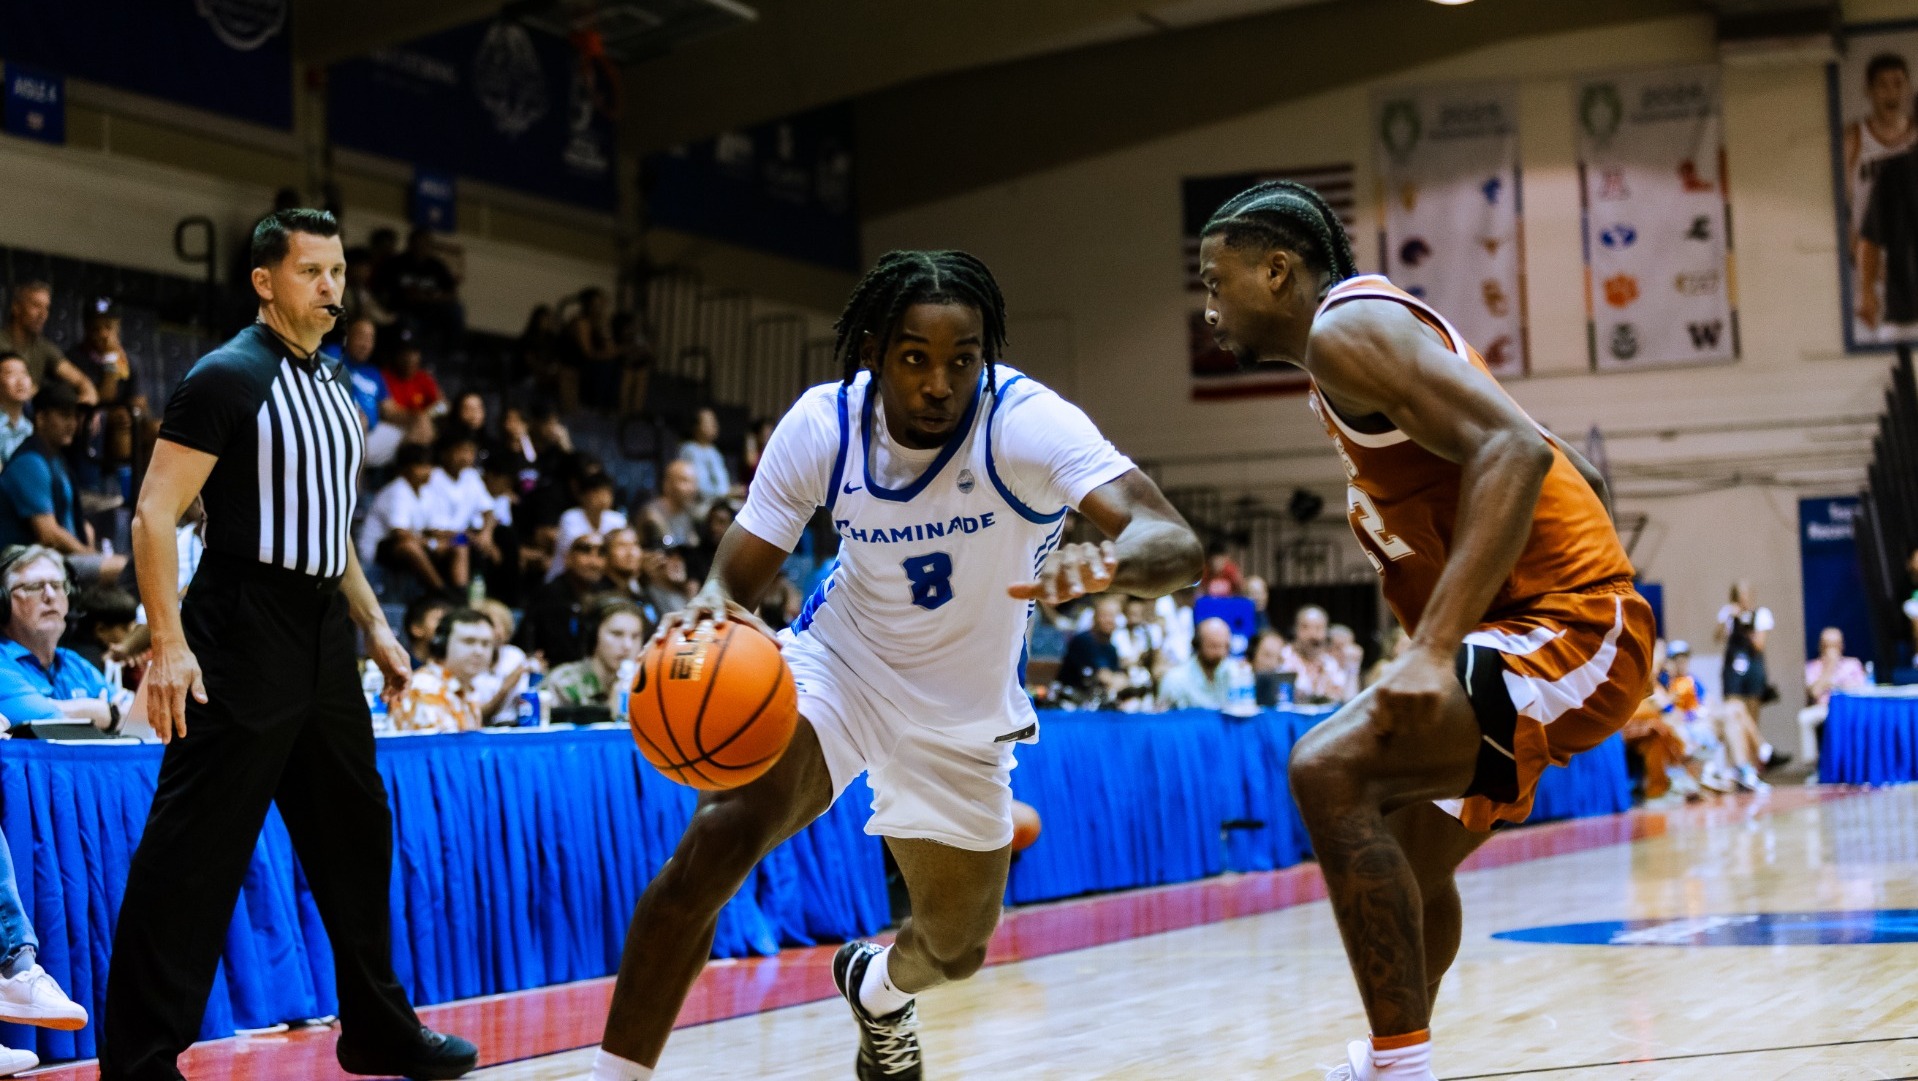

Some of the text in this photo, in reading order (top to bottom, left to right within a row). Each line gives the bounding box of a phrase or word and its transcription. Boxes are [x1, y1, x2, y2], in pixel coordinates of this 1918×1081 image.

[835, 512, 996, 543] CHAMINADE
[1347, 482, 1416, 576] 2
[900, 550, 955, 611] 8
